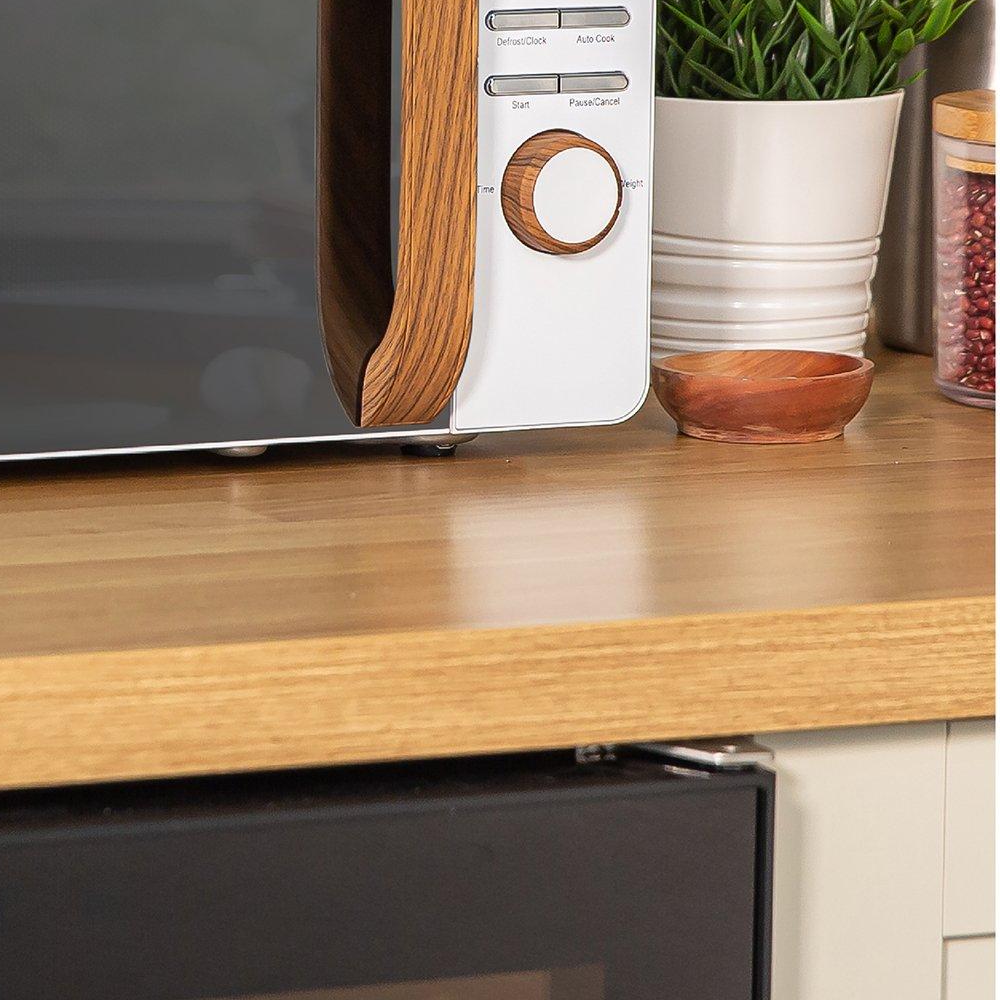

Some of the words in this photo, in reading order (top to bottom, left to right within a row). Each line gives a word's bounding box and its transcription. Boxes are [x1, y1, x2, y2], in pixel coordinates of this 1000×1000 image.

[497, 37, 547, 47] Defrost/Clock
[577, 35, 594, 44] Auto
[595, 34, 615, 44] Cook
[512, 101, 530, 110] Start
[570, 97, 621, 108] Pause/Cancel
[477, 185, 494, 194] Time
